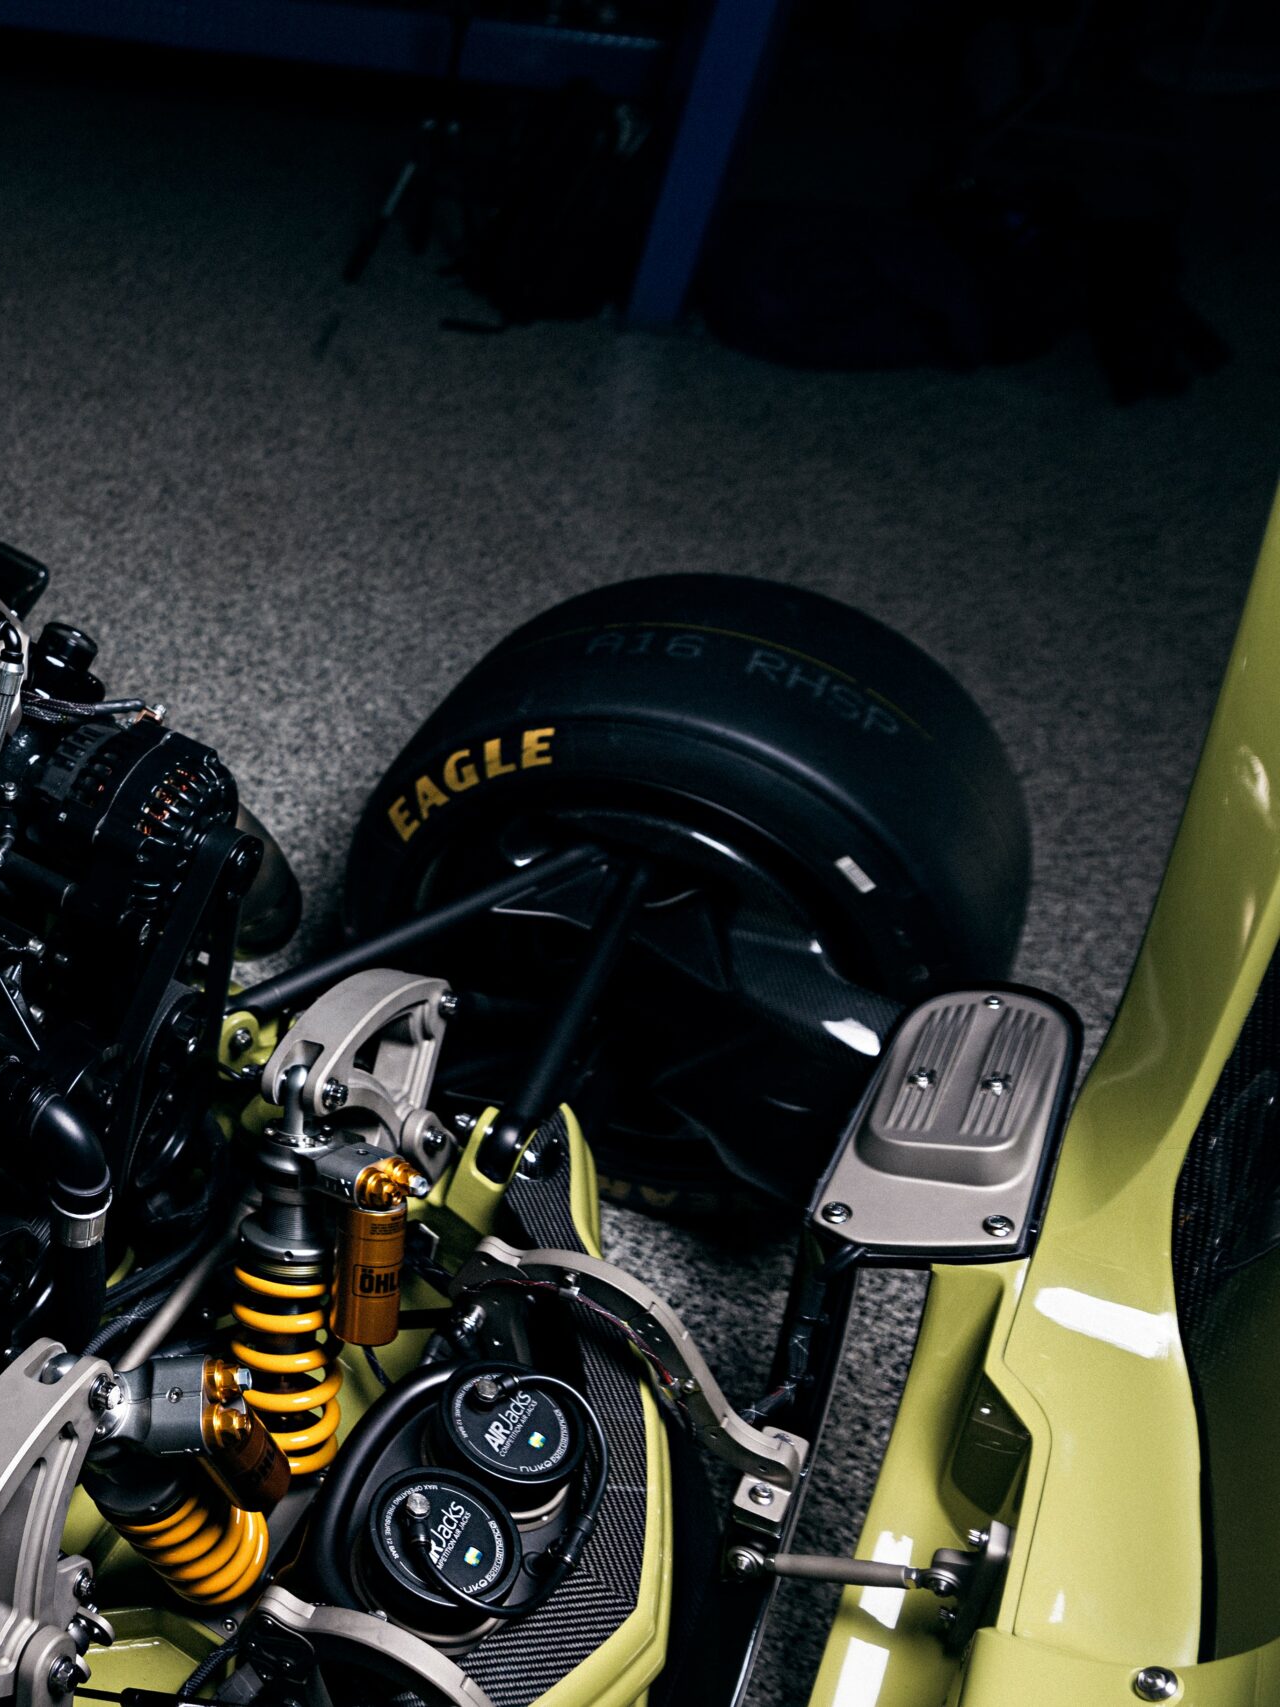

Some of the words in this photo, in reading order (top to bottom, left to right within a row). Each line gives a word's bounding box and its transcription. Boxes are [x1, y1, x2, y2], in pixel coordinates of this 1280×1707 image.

[585, 631, 706, 658] A16
[386, 726, 557, 846] EAGLE
[499, 1421, 524, 1457] COMPETITION
[520, 1414, 529, 1427] AIR
[526, 1400, 538, 1417] JACKS
[385, 1504, 397, 1536] PRESSURE
[388, 1544, 400, 1560] BAR
[436, 1538, 458, 1570] MPETITION
[453, 1529, 463, 1542] AIR
[459, 1511, 472, 1531] JACKS
[460, 1579, 488, 1594] uke
